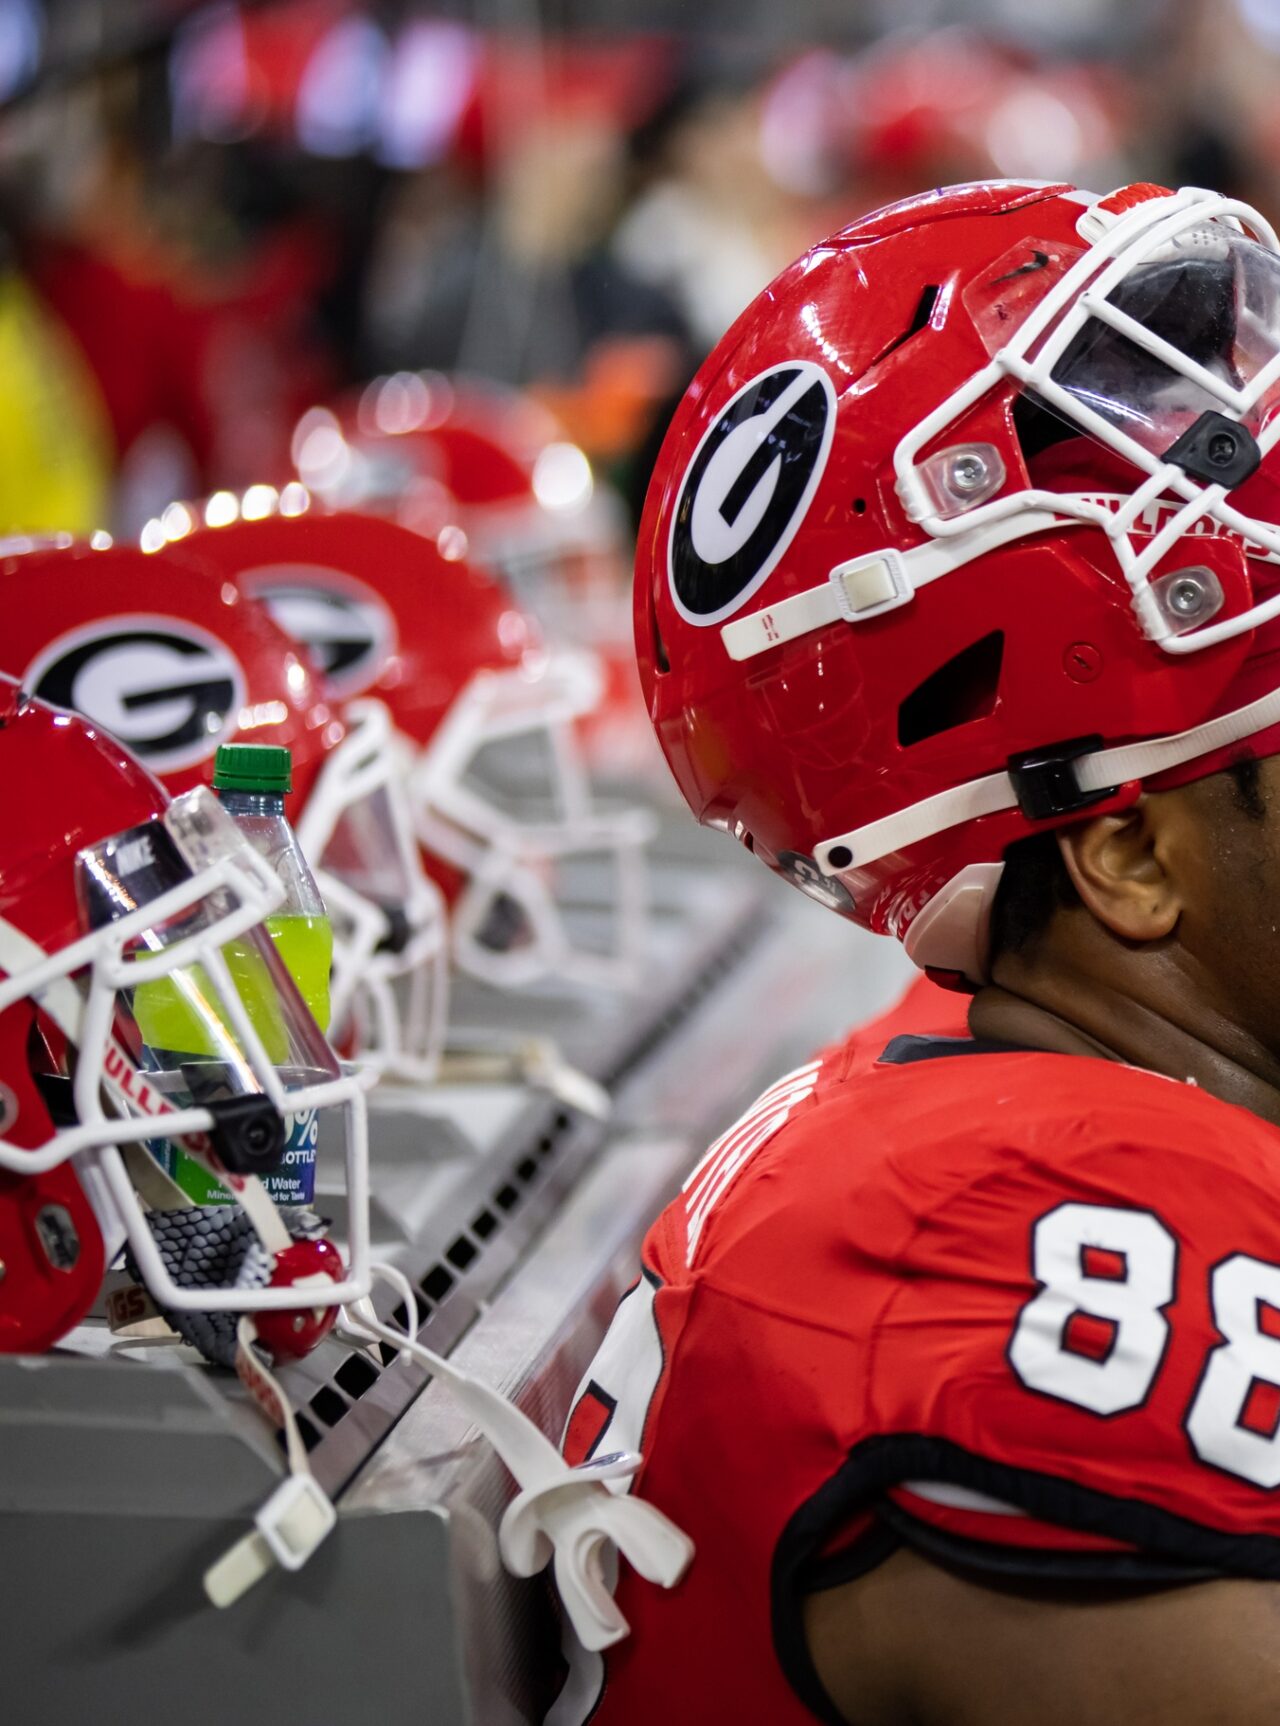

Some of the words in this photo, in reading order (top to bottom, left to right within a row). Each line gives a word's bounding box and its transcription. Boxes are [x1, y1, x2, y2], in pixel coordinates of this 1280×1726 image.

[670, 364, 833, 622] G
[26, 622, 242, 766] G
[271, 1177, 301, 1190] Water
